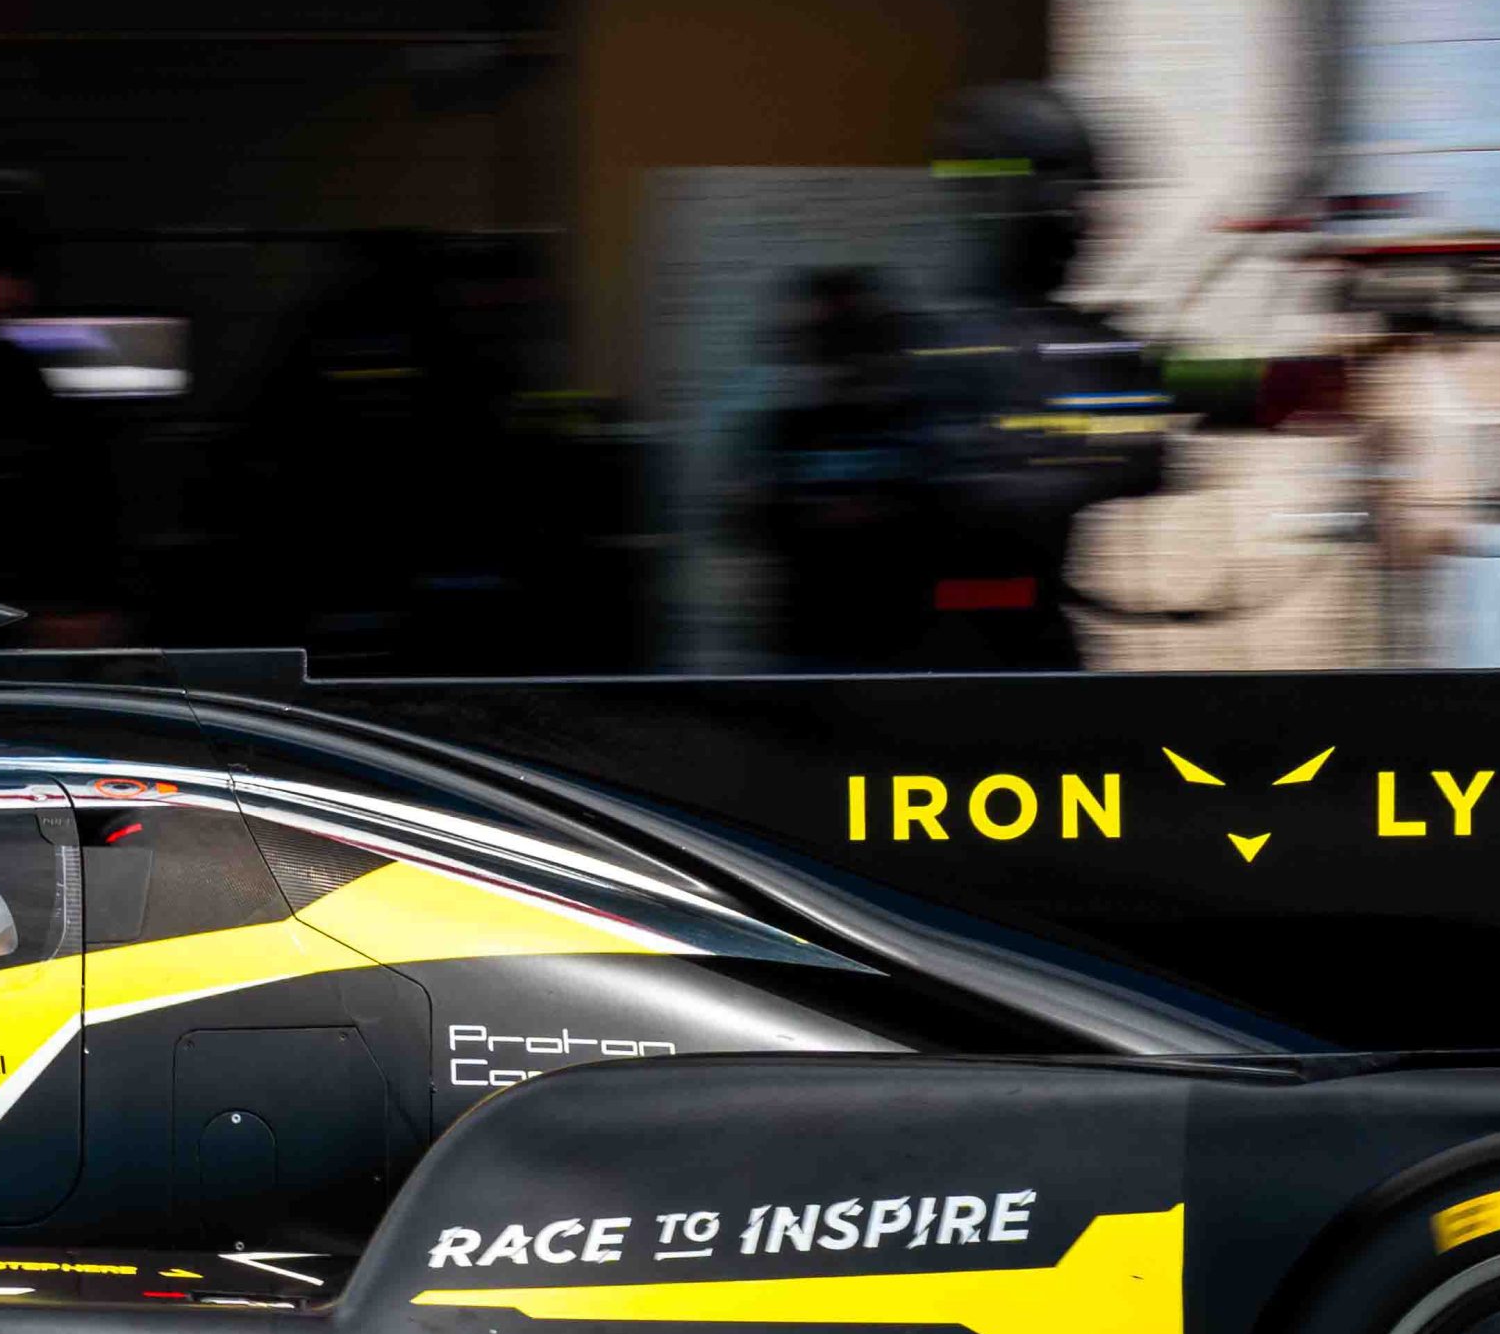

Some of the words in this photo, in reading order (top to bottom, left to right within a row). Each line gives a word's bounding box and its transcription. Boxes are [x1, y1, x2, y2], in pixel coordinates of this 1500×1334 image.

[848, 773, 1121, 841] IRON
[427, 1217, 632, 1268] RACE
[655, 1211, 719, 1243] TO
[740, 1189, 1037, 1255] INSPIRE
[62, 1263, 138, 1275] HERE
